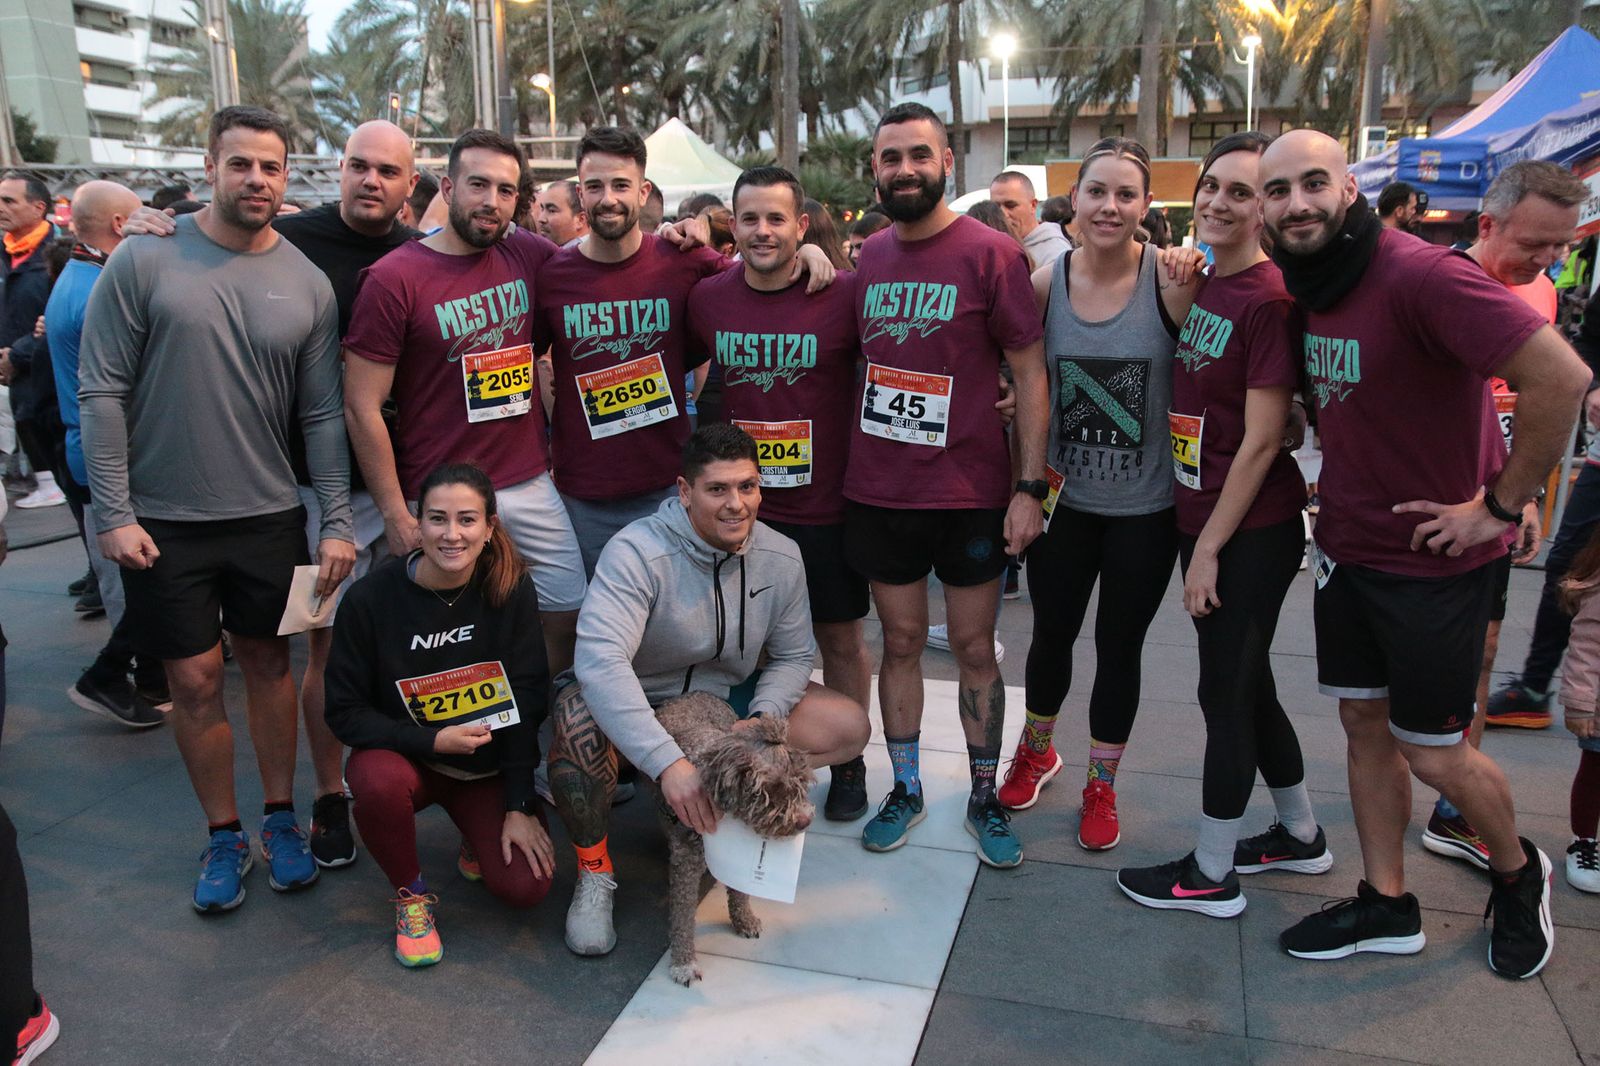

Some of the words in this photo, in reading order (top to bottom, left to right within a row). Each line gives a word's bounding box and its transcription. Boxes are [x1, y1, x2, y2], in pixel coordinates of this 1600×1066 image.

[434, 279, 529, 340] MESTIZO
[863, 282, 958, 321] MESTIZO
[563, 298, 670, 339] MESTIZO
[1179, 302, 1234, 359] ESTIZO
[715, 331, 818, 369] MESTIZO
[487, 367, 529, 392] 2055
[599, 378, 657, 408] 2650
[624, 404, 647, 418] SERGIO
[888, 393, 926, 419] 45
[890, 416, 905, 428] JOSE
[905, 418, 921, 430] LUIS
[1171, 435, 1189, 456] 27
[761, 466, 788, 475] CRISTIAN
[410, 624, 475, 650] NIKE
[429, 683, 496, 714] 2710
